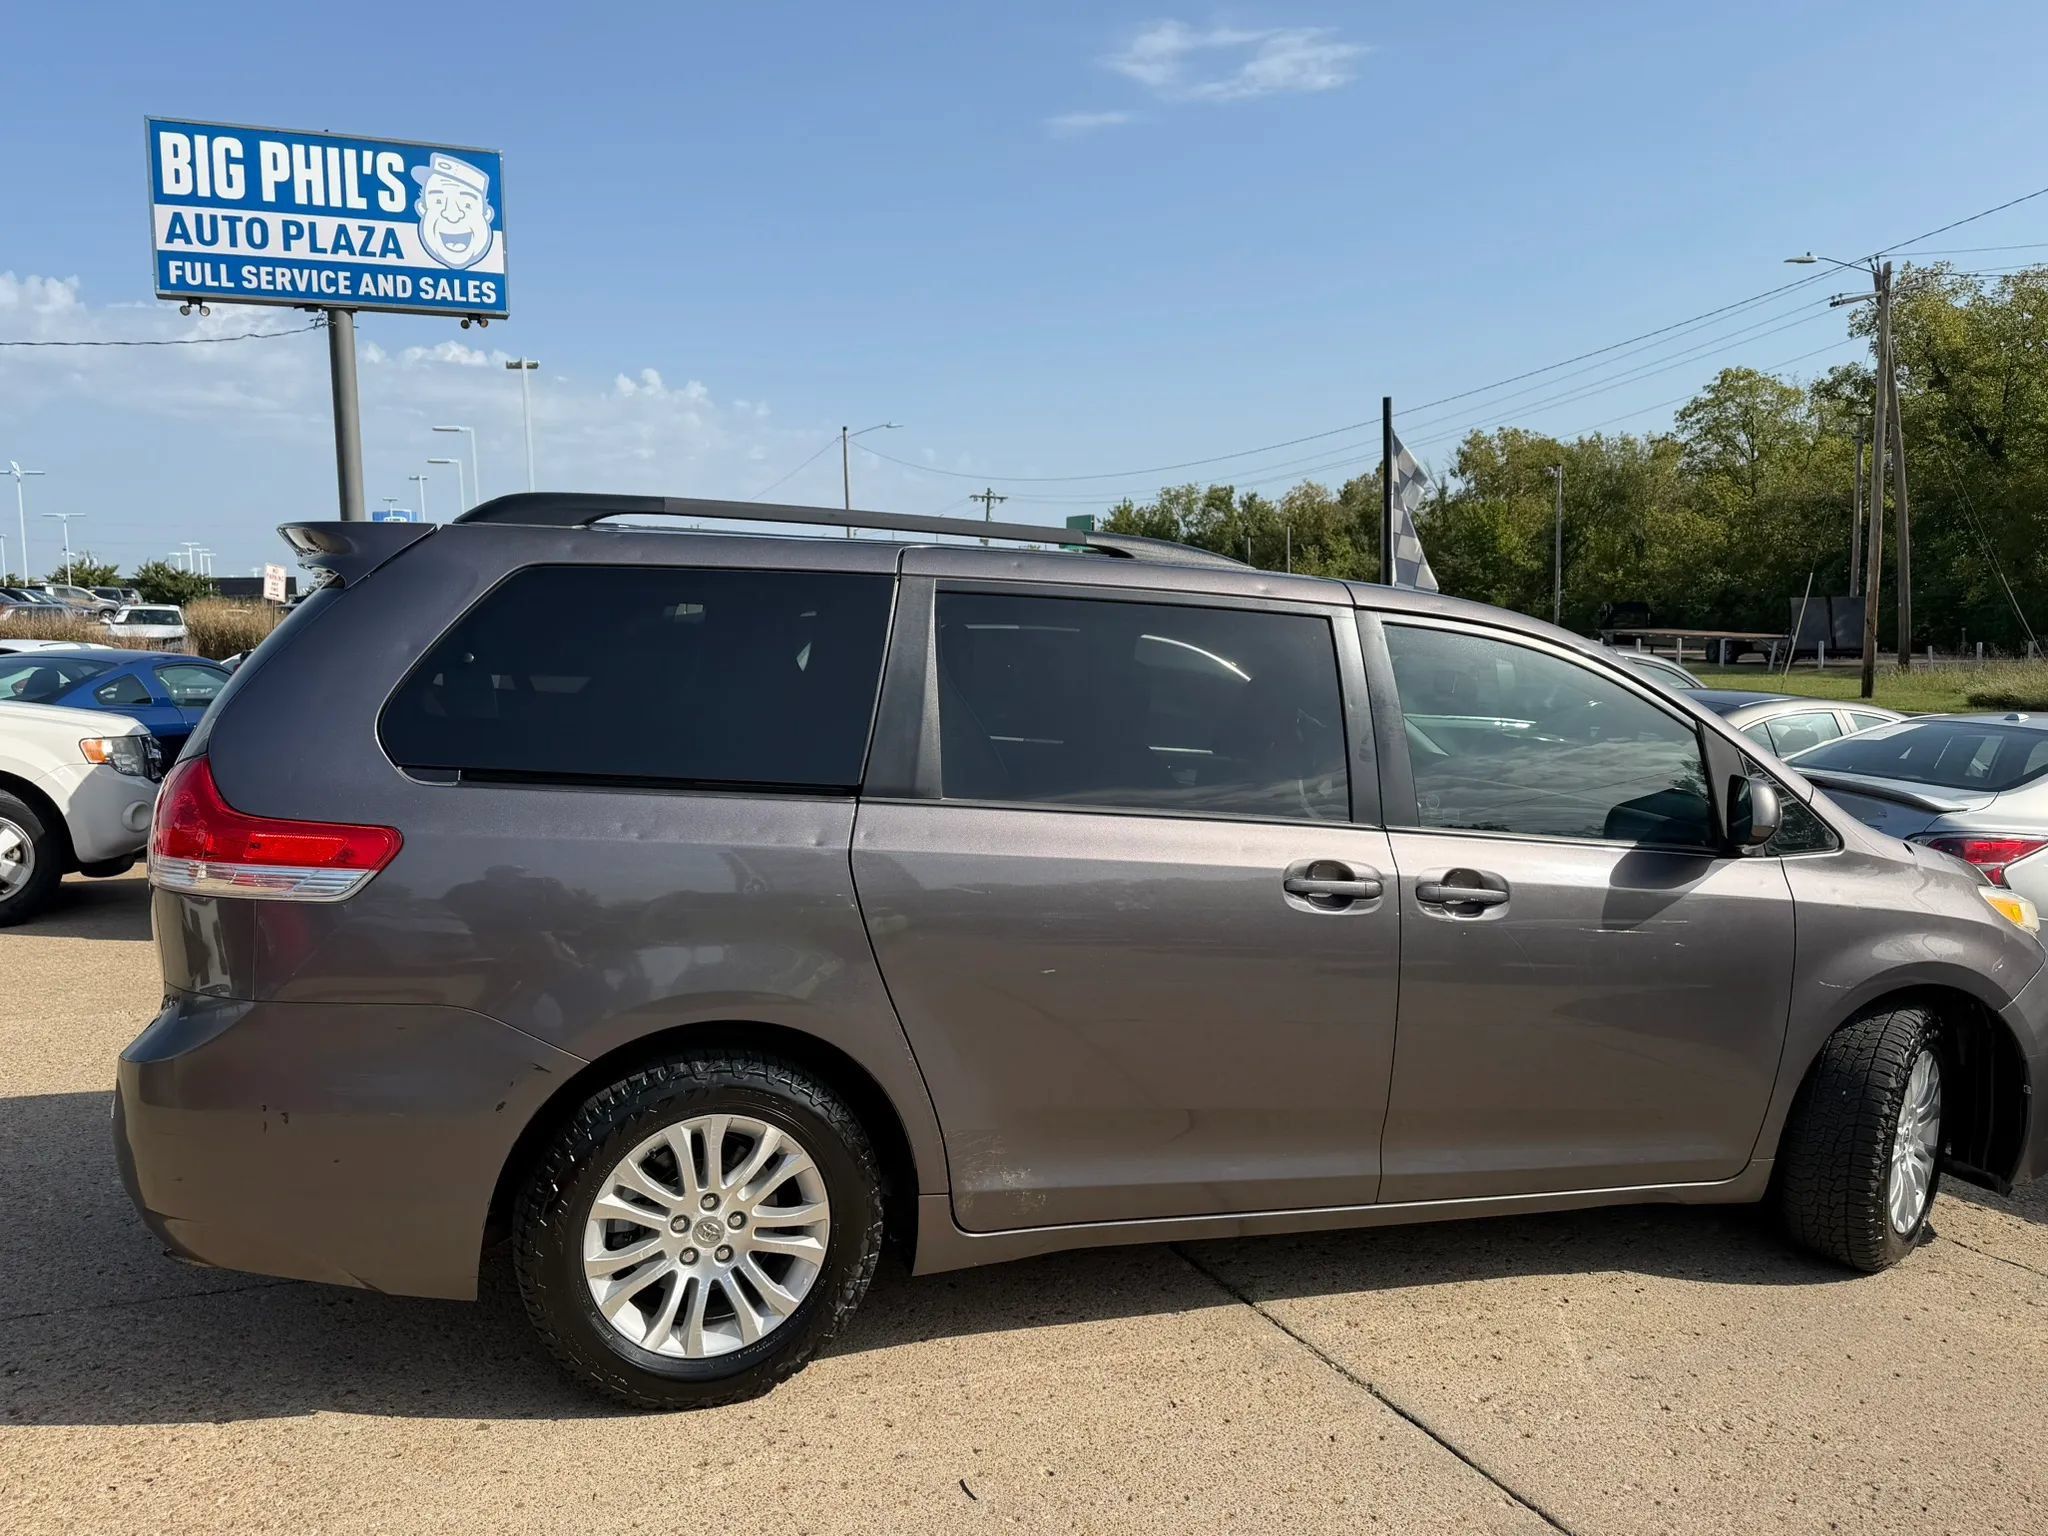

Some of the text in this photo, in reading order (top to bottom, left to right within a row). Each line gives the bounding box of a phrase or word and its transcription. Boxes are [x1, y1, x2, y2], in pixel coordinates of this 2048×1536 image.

[159, 131, 407, 213] BIG PHIL'S
[165, 211, 405, 260] AUTO PLAZA
[169, 260, 497, 304] FULL SERVICE AND SALES
